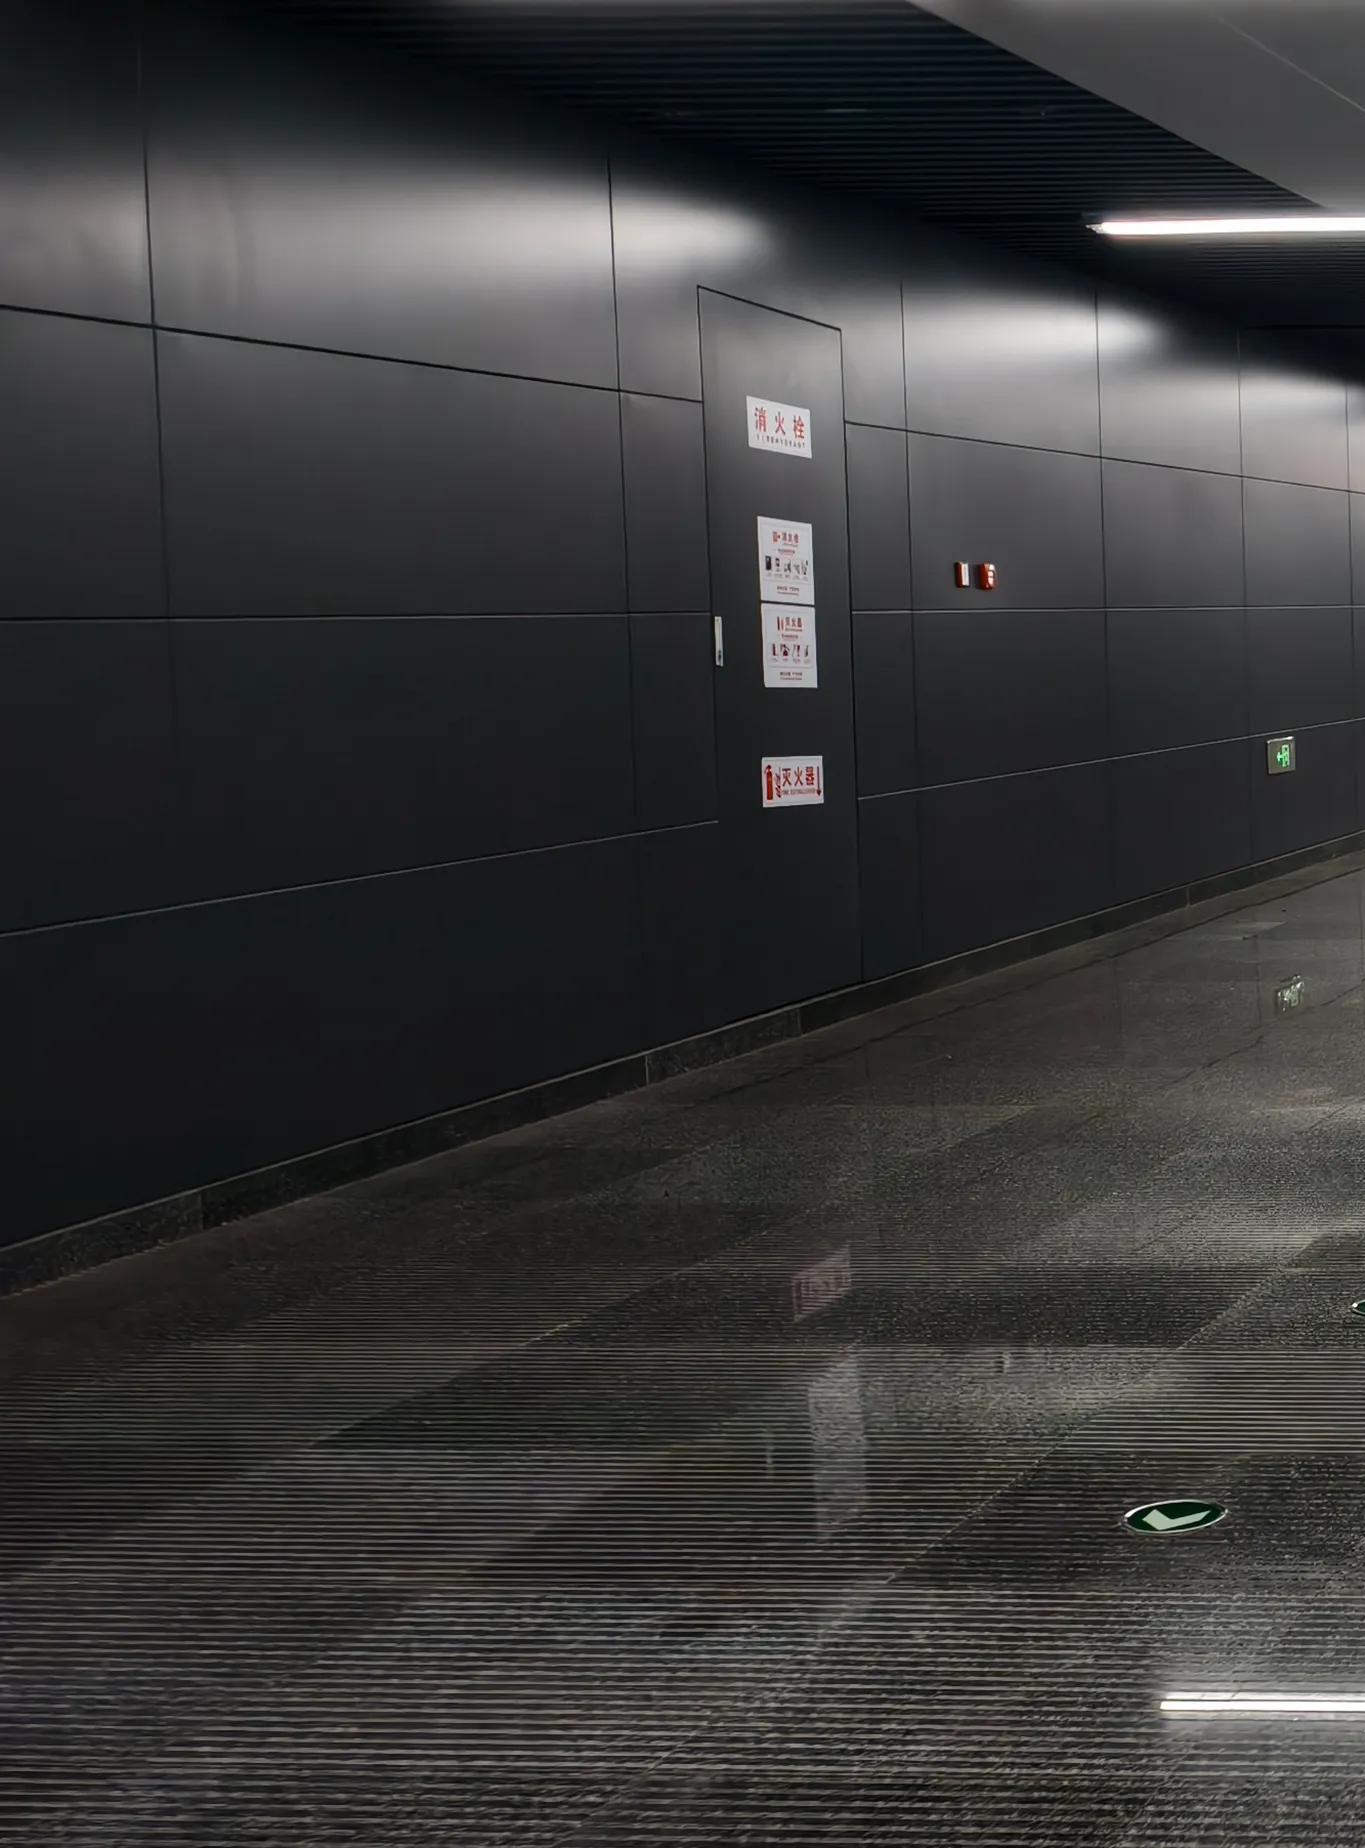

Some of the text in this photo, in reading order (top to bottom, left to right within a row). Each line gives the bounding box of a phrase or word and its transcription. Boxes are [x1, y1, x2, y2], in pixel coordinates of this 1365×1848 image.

[754, 406, 805, 439] 消火栓
[782, 766, 815, 786] 灭火器
